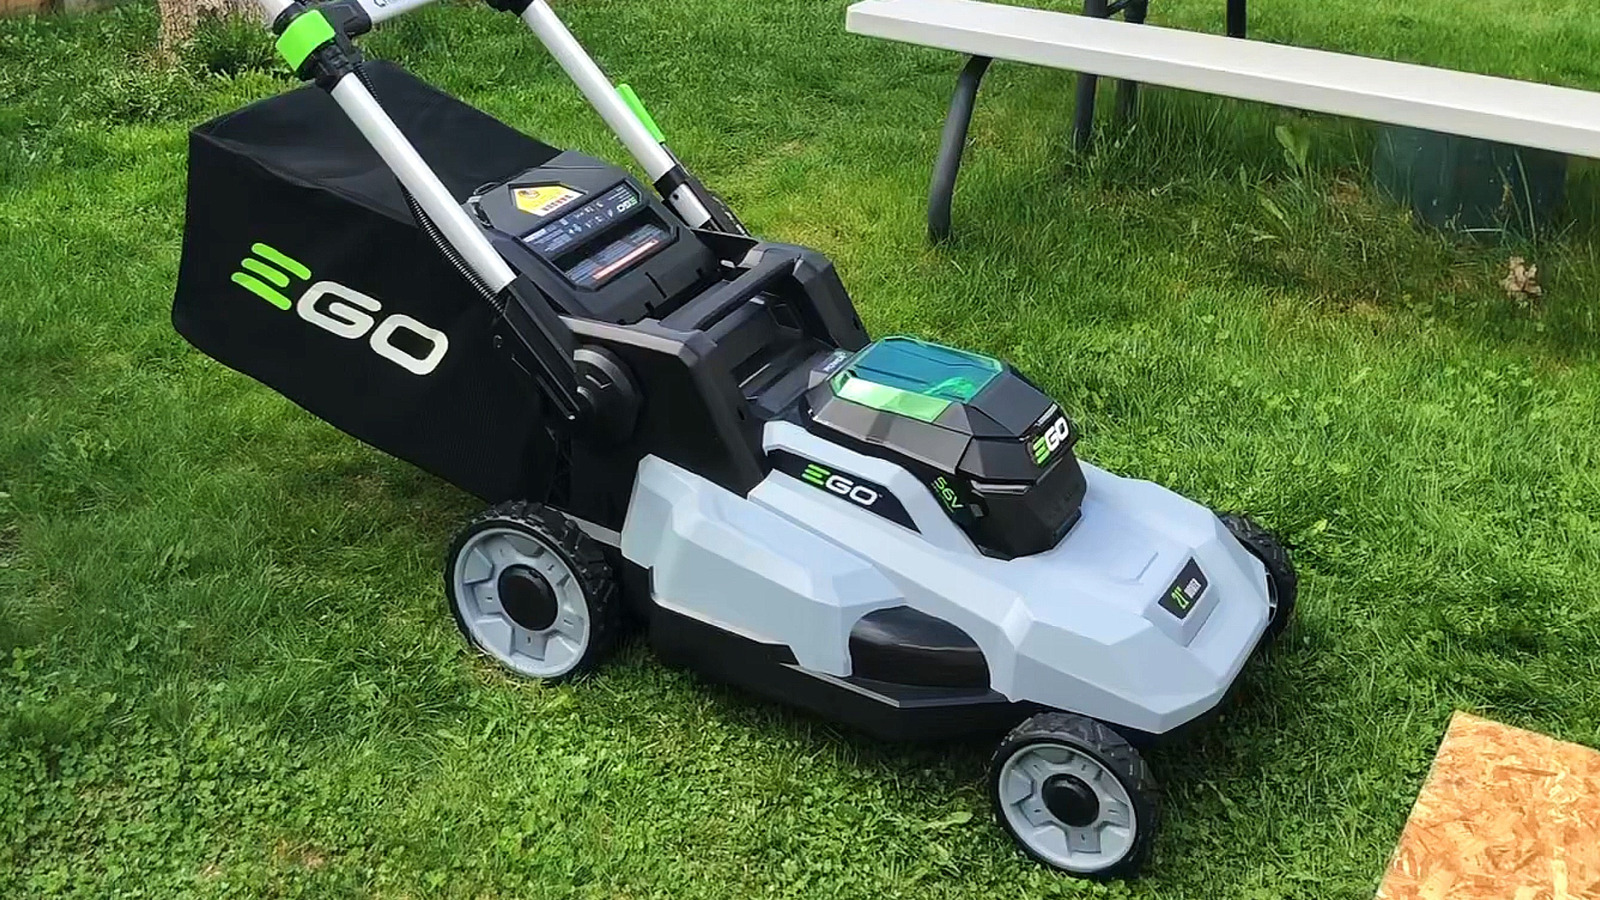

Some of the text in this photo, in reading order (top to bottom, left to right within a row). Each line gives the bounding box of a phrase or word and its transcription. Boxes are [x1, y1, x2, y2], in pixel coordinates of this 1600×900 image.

[616, 196, 638, 213] EGO
[231, 243, 449, 375] EGO
[1033, 416, 1069, 464] EGO
[801, 464, 878, 506] EGO
[934, 476, 964, 509] 56V
